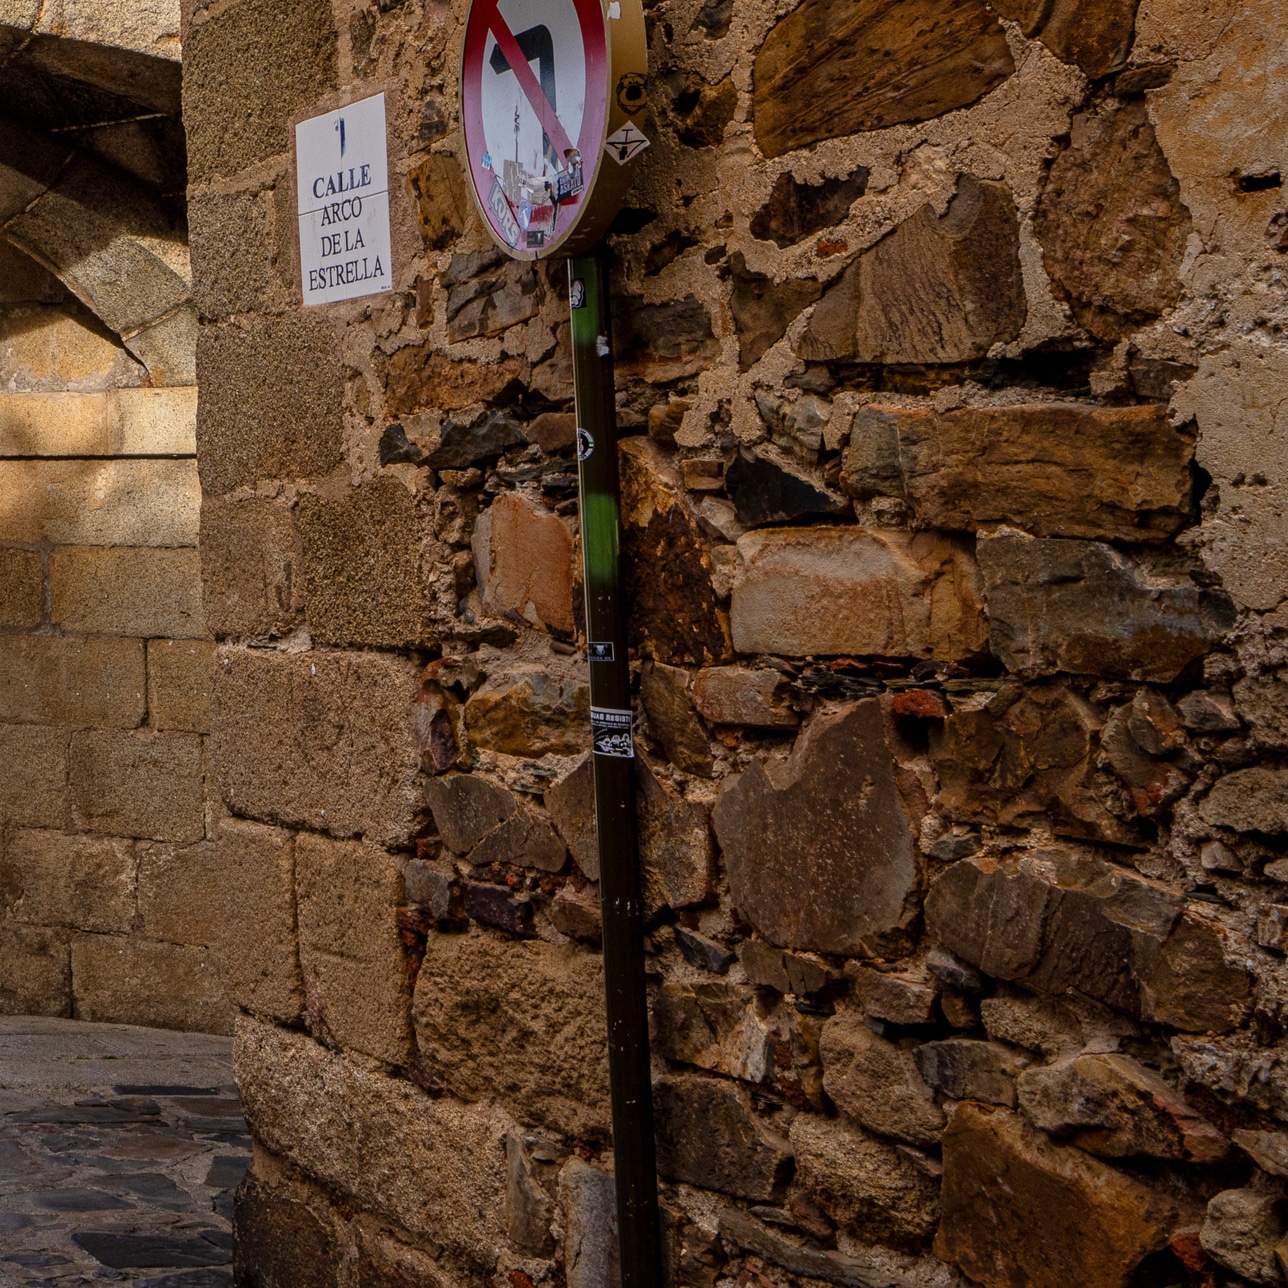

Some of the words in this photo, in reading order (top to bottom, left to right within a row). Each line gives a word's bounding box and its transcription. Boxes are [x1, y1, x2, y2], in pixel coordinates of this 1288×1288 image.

[312, 164, 372, 199] CALLE
[320, 196, 362, 227] ARCO
[320, 233, 342, 258] DE
[344, 227, 366, 252] LA
[309, 254, 385, 292] ESTRELLA
